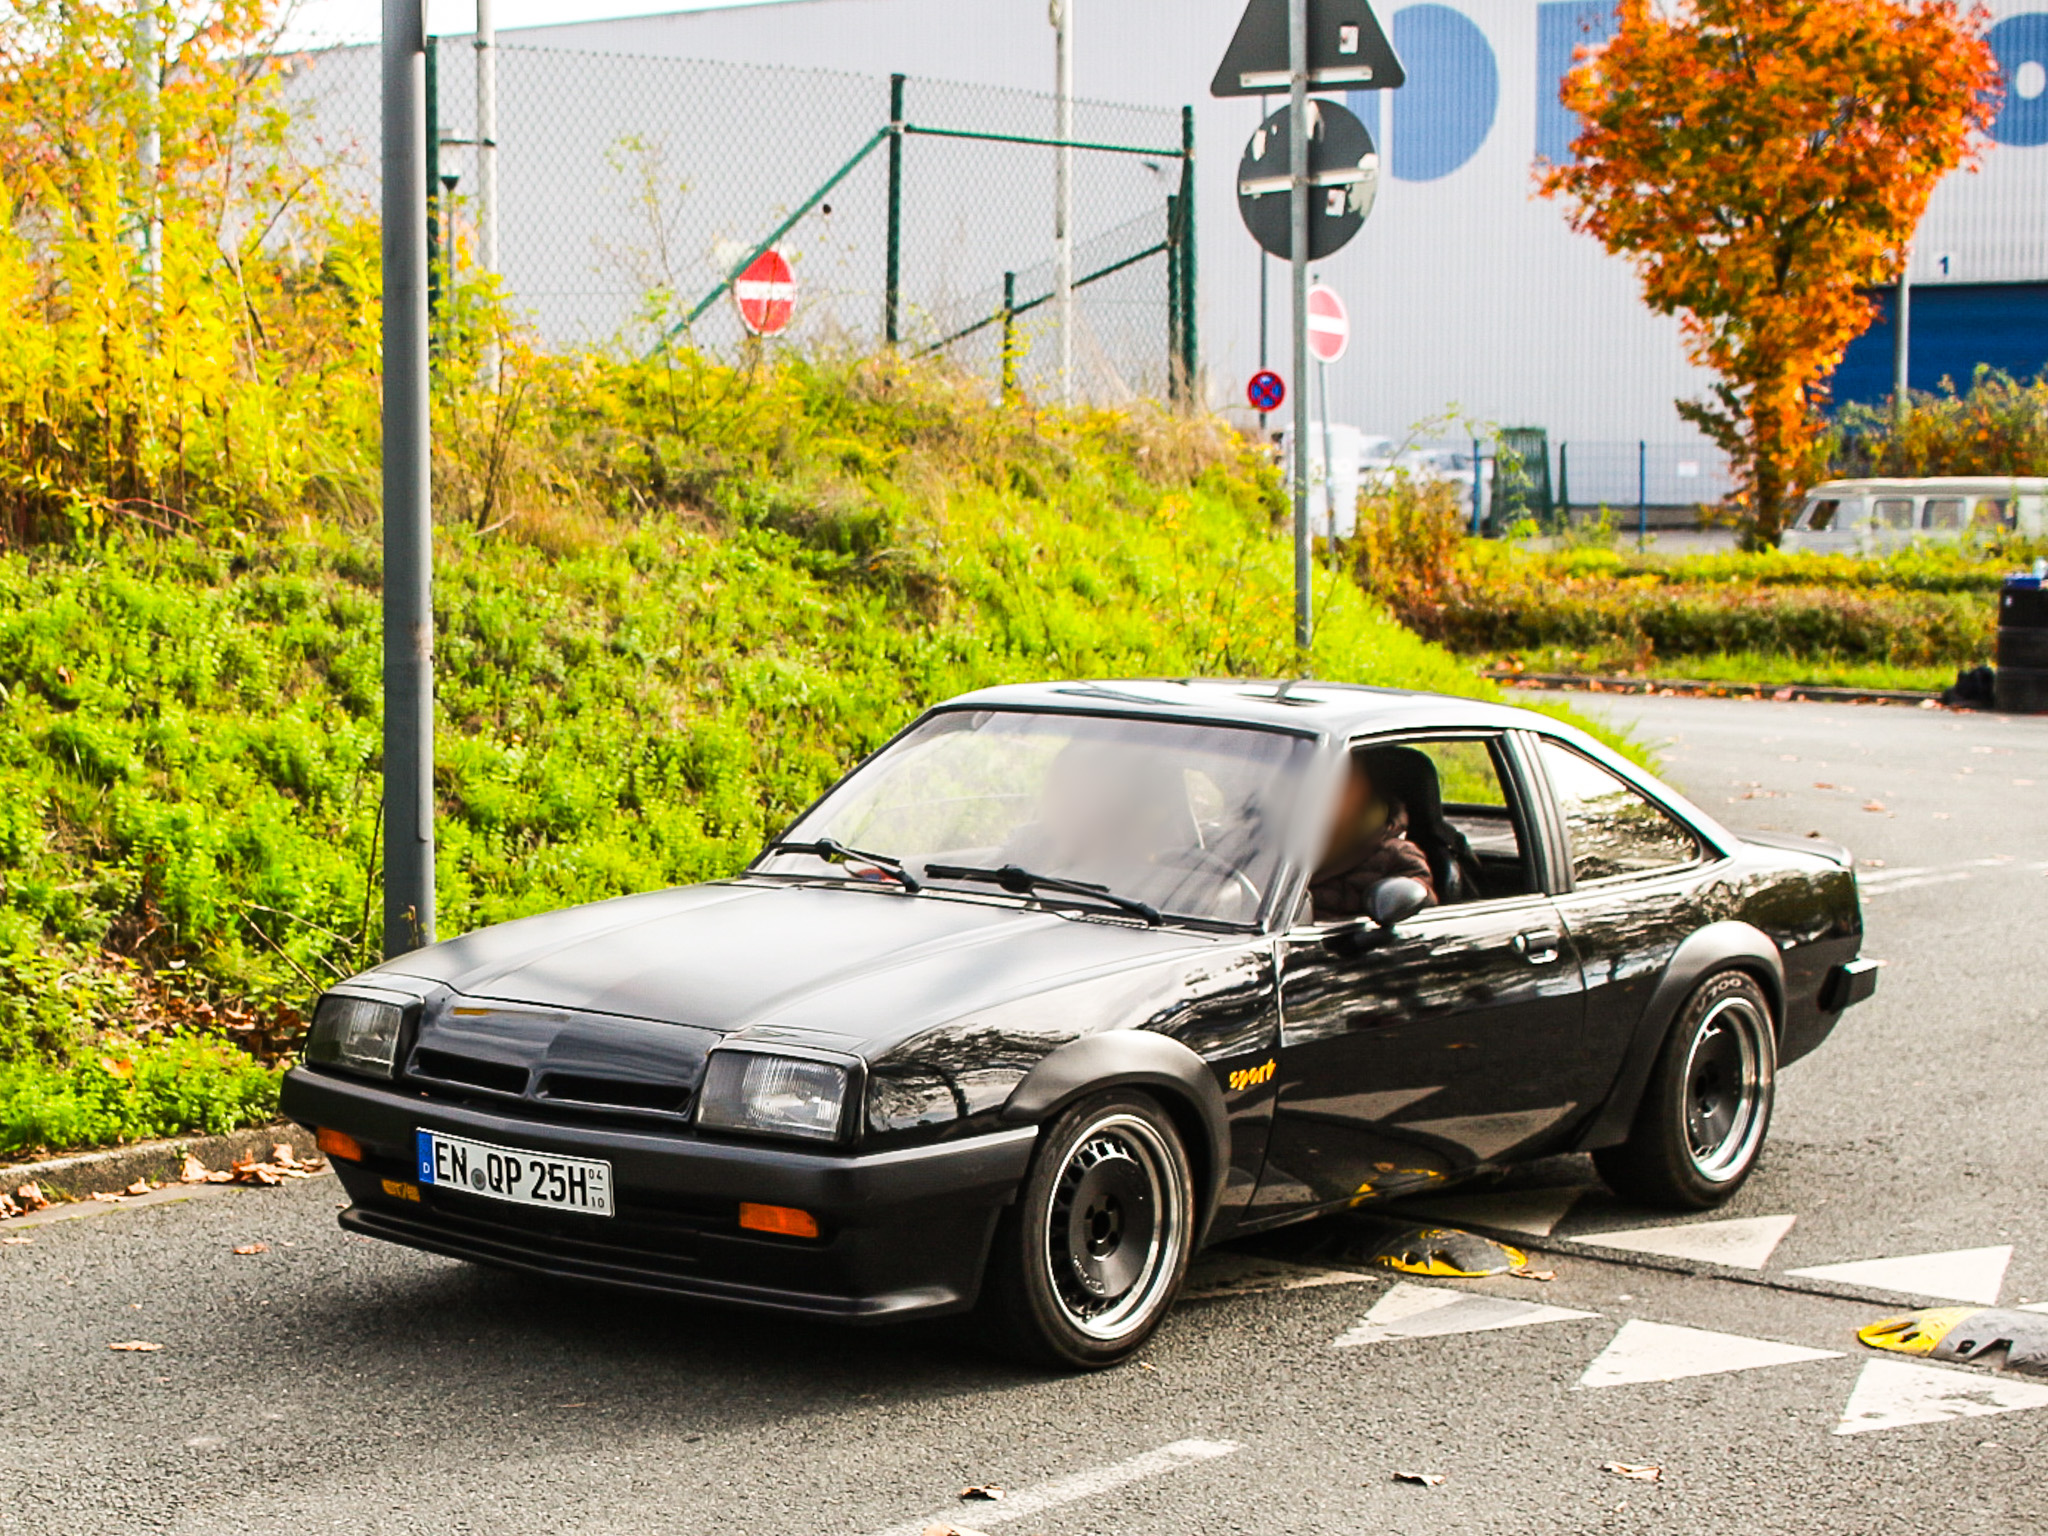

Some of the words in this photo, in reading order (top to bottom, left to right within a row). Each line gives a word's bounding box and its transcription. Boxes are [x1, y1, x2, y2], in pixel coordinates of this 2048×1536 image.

[1939, 255, 1949, 275] 1
[1229, 1058, 1277, 1091] sport
[423, 1162, 430, 1174] D
[435, 1142, 467, 1185] EN
[487, 1153, 522, 1195] QP
[530, 1161, 587, 1206] 25H
[589, 1168, 603, 1180] 04
[592, 1197, 605, 1208] 10
